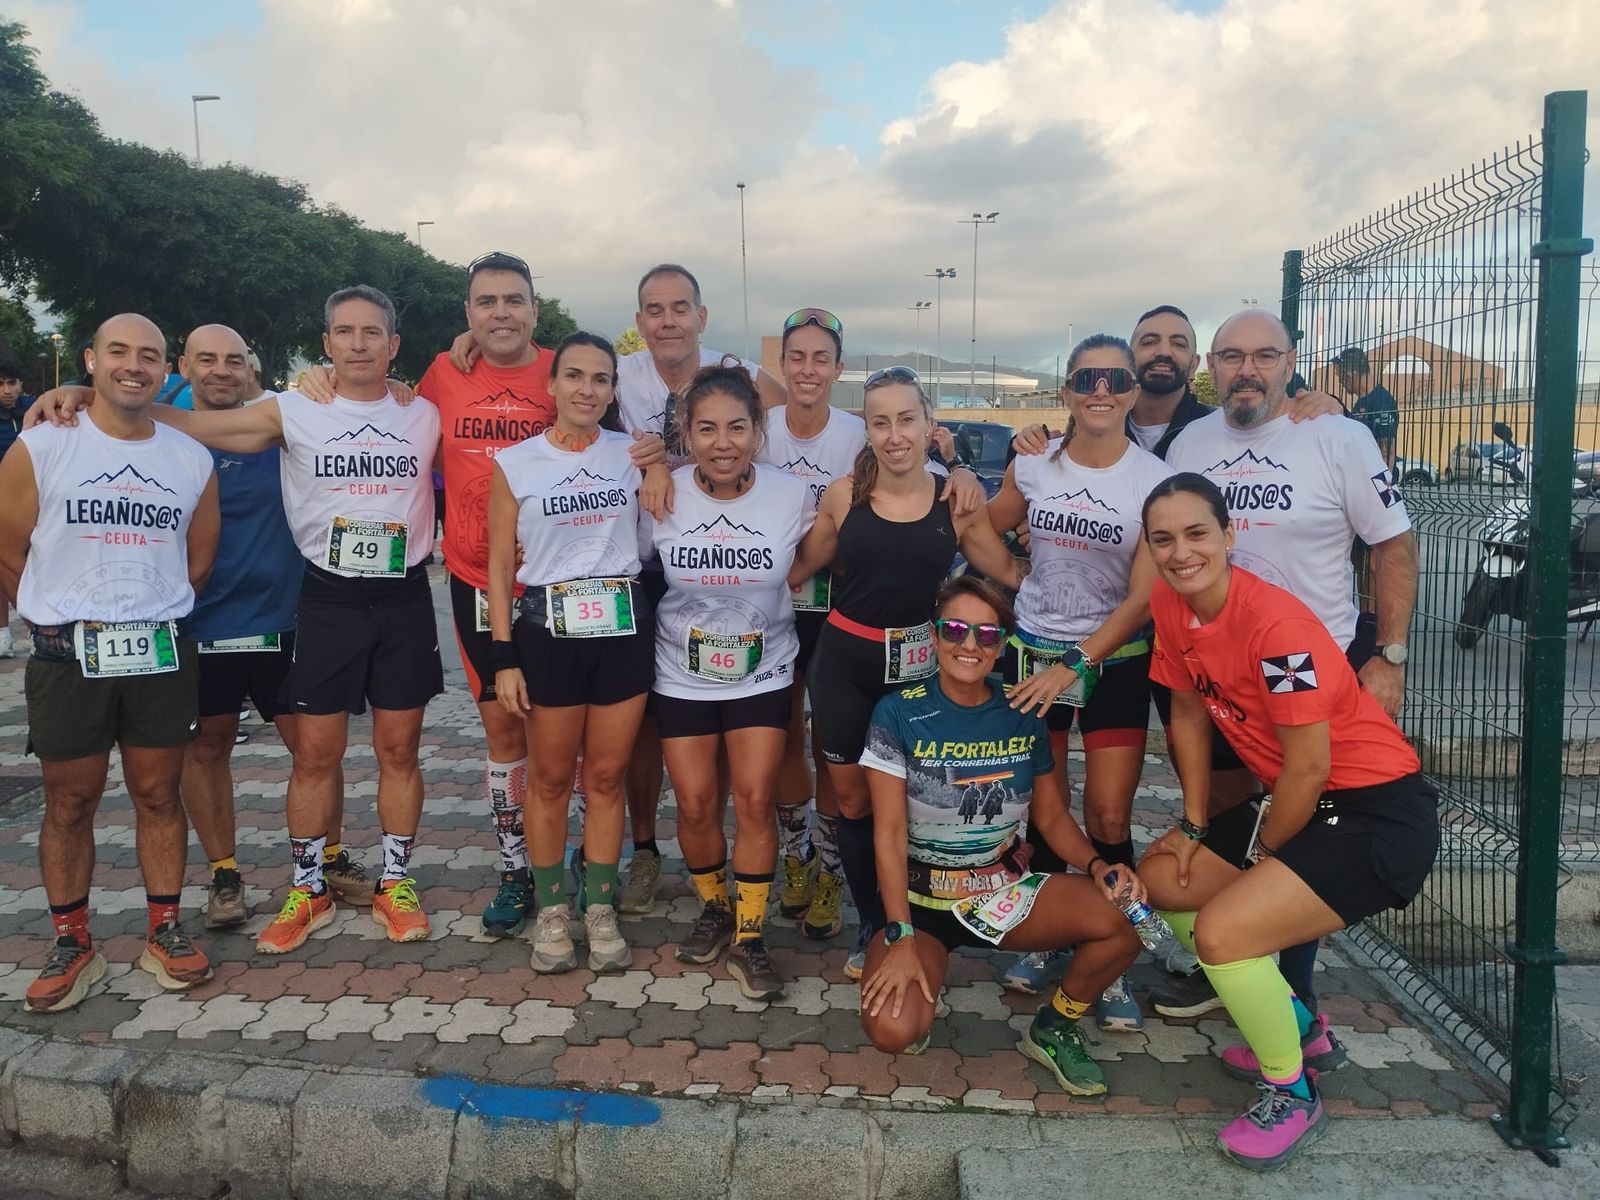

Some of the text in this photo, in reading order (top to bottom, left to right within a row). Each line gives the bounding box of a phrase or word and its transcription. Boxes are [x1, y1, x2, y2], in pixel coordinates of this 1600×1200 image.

[454, 416, 554, 441] LEGAÑOS@
[315, 452, 418, 478] LEGAÑOS@S
[349, 484, 388, 495] CEUTA
[1218, 482, 1293, 511] ÑOS@S
[543, 489, 628, 516] LEGAÑOS@S
[66, 497, 182, 531] LEGAÑOS@S
[573, 513, 604, 526] CEUTA
[1031, 508, 1124, 545] LEGAÑOS@S
[105, 532, 147, 545] CEUTA
[1055, 537, 1089, 551] CEUTA
[352, 541, 379, 559] 49
[670, 544, 773, 570] LEGAÑOS@S
[701, 575, 741, 586] CEUTA
[578, 586, 621, 595] FORTALEZA
[577, 601, 604, 620] 35
[106, 637, 149, 657] 119
[713, 640, 756, 648] FORTALEZA
[710, 653, 735, 668] 46
[753, 670, 773, 683] 2025
[913, 739, 938, 759] LA
[920, 758, 942, 768] 1ER
[943, 756, 1009, 768] CORRERÍAS
